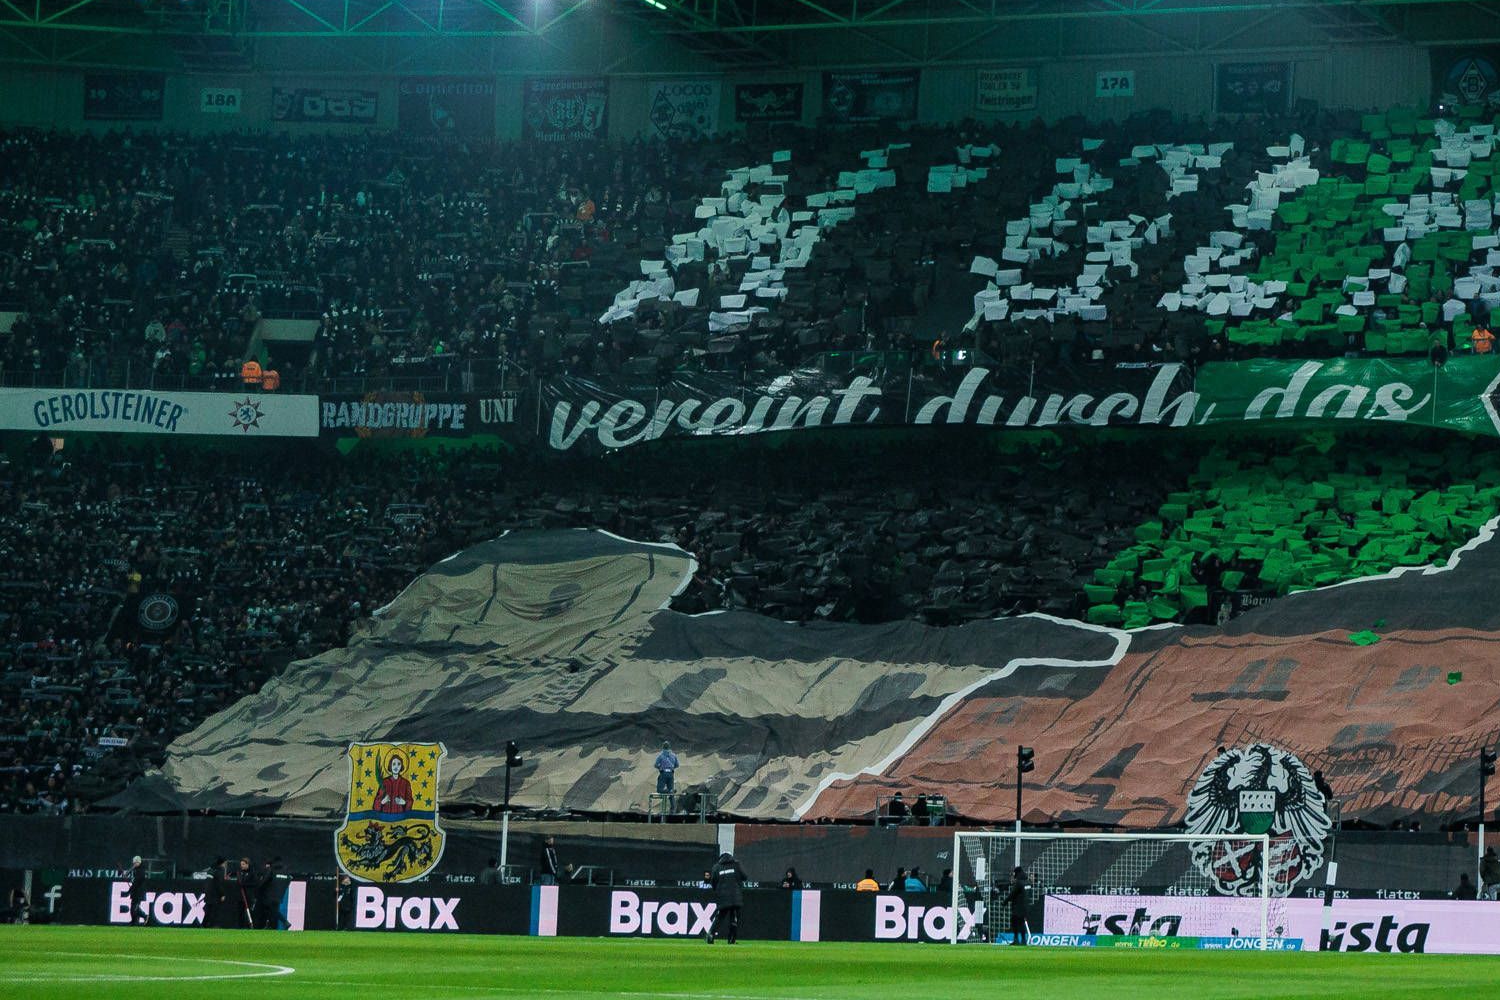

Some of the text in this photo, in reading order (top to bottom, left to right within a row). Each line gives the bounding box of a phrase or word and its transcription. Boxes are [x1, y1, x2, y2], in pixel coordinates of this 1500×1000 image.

[205, 94, 236, 106] 18A
[1102, 78, 1130, 90] 17A
[34, 392, 183, 432] GEROLSTEINER
[322, 402, 466, 430] RANDGRUPPE
[549, 376, 883, 450] vereint
[914, 362, 1218, 427] durch
[1244, 362, 1431, 421] das
[356, 886, 460, 930] Brax
[1306, 886, 1350, 900] flaex
[1376, 888, 1421, 900] flatex
[610, 890, 717, 936] Brax
[875, 895, 987, 941] Brax
[1225, 938, 1284, 950] JONGEN
[1320, 916, 1430, 953] ista
